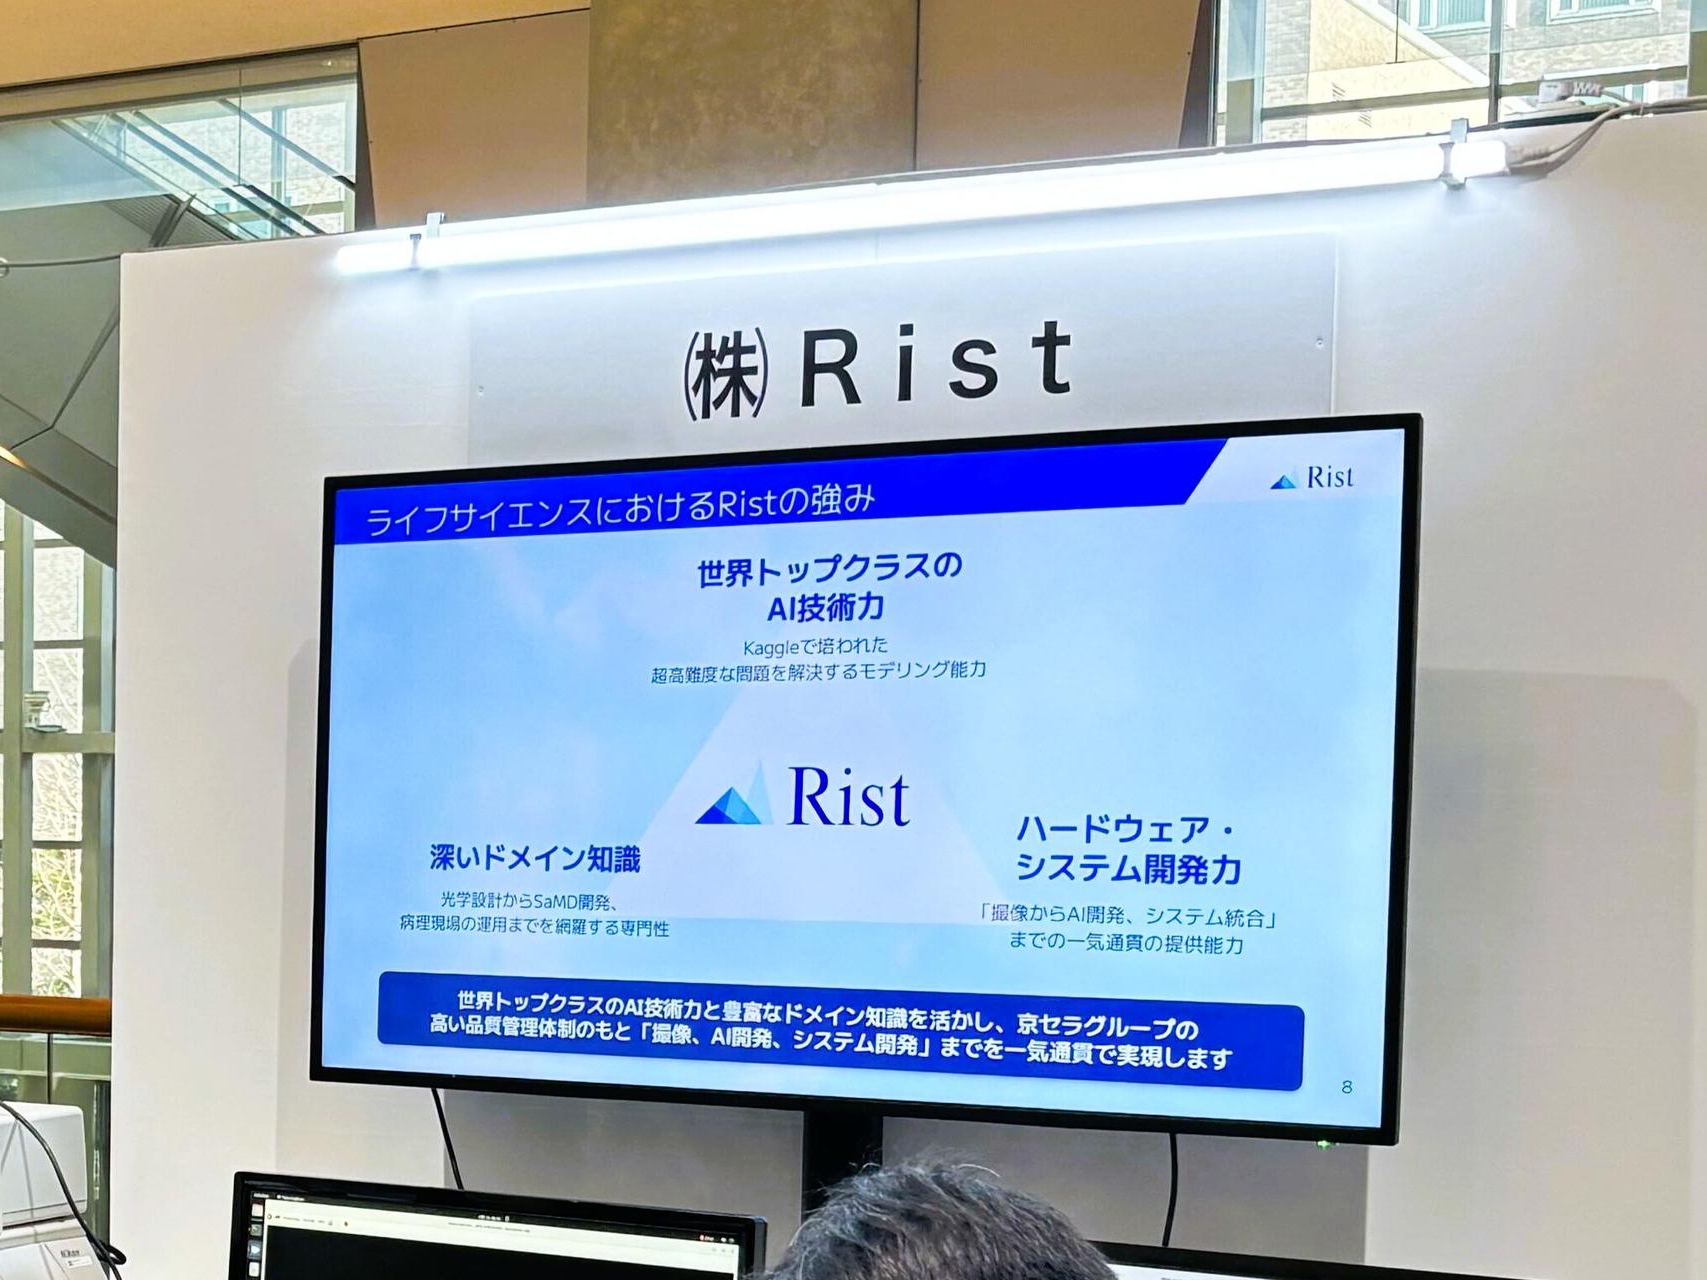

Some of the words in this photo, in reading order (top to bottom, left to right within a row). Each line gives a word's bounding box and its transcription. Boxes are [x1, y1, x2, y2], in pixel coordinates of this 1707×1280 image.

[1308, 465, 1355, 489] Rist
[366, 483, 876, 537] ライフサイエンスにおけるRistの強み
[697, 551, 963, 589] 世界トップクラスの
[767, 590, 885, 624] AI技術力
[743, 636, 889, 659] Kaggleで培われた
[650, 660, 987, 685] 超高難度な問題を解決するモデリング能力
[786, 766, 911, 827] Rist
[1016, 813, 1235, 844] ハードウェア・
[429, 844, 641, 874] 深いドメイン知識
[1016, 853, 1242, 887] システム開発力
[440, 891, 617, 912] 光学設計からSaMD開発、
[400, 914, 670, 938] 病理現場の運用までを網羅する専門性
[1009, 931, 1244, 956] までの一気通貫の提供能力
[1341, 1080, 1353, 1094] 8
